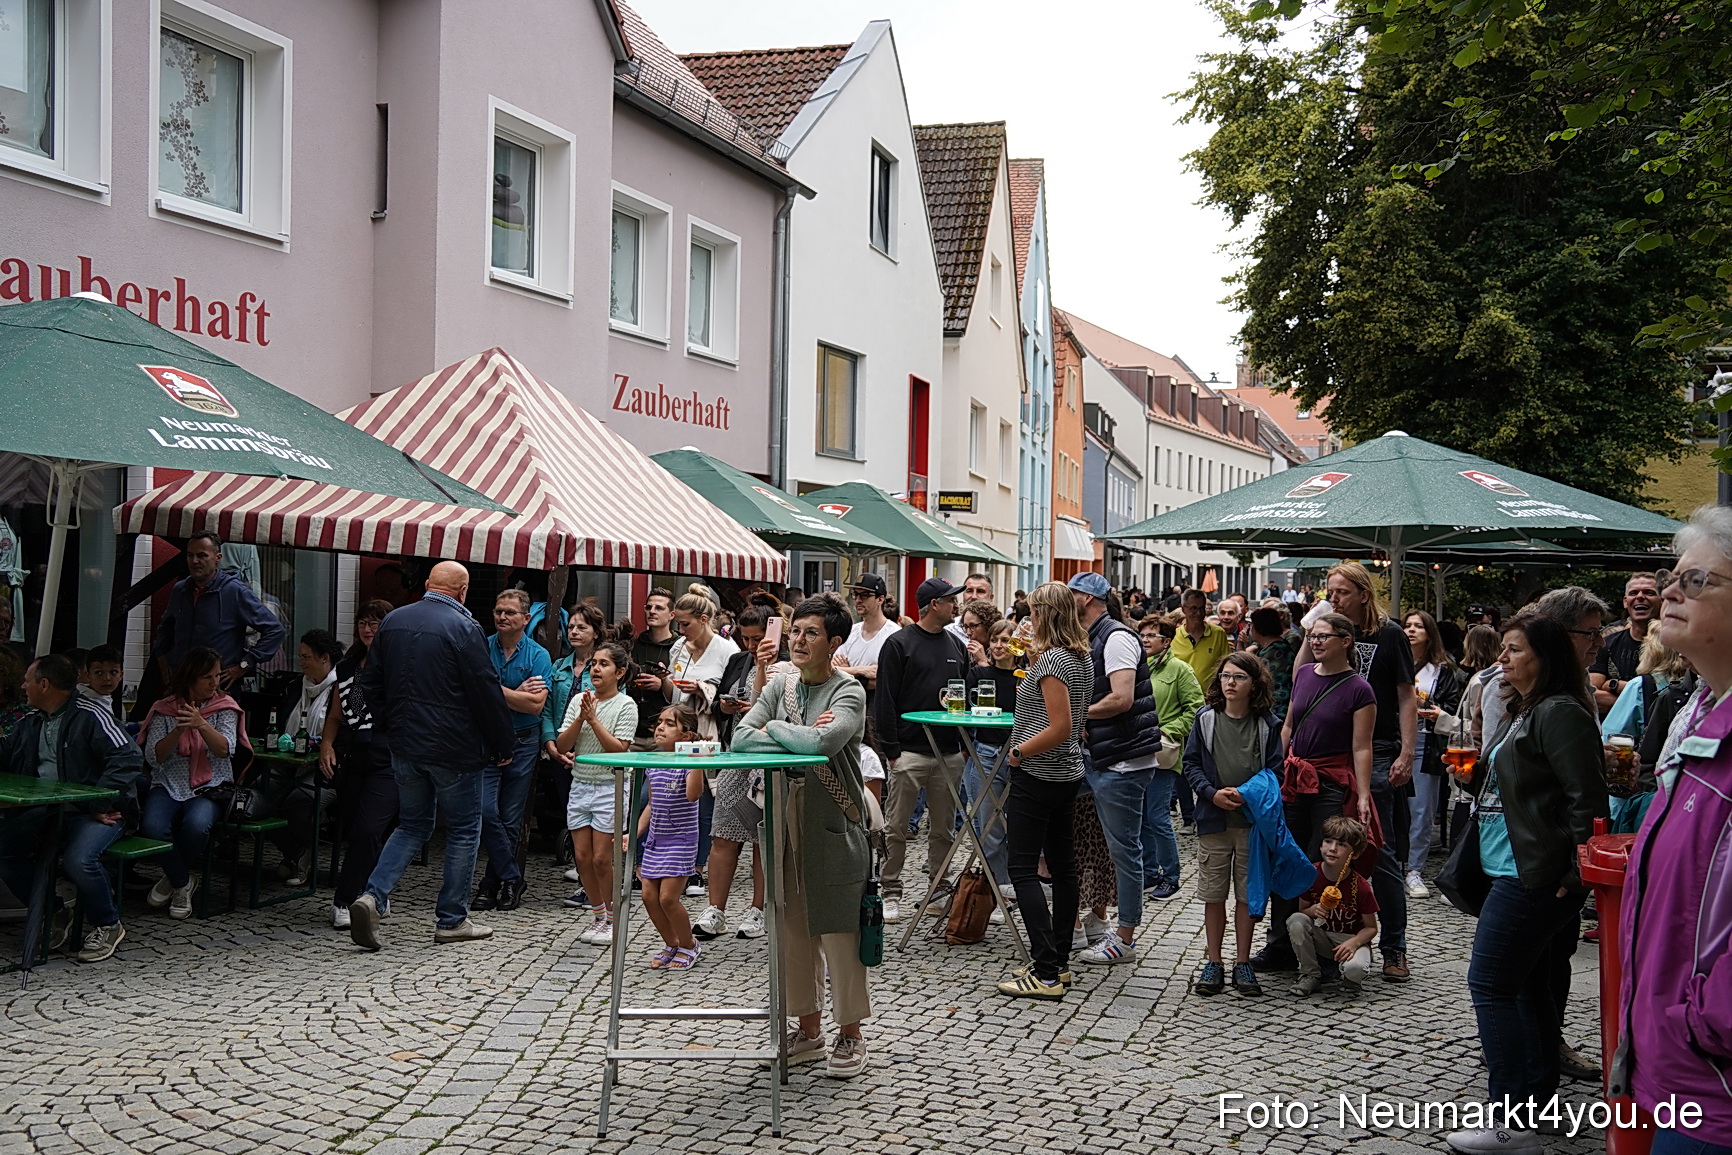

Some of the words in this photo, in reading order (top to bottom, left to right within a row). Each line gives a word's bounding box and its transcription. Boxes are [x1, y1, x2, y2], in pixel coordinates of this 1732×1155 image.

[612, 373, 730, 431] Zauberhaft
[148, 428, 333, 470] Lammsbräu
[160, 416, 292, 447] Neumarkter
